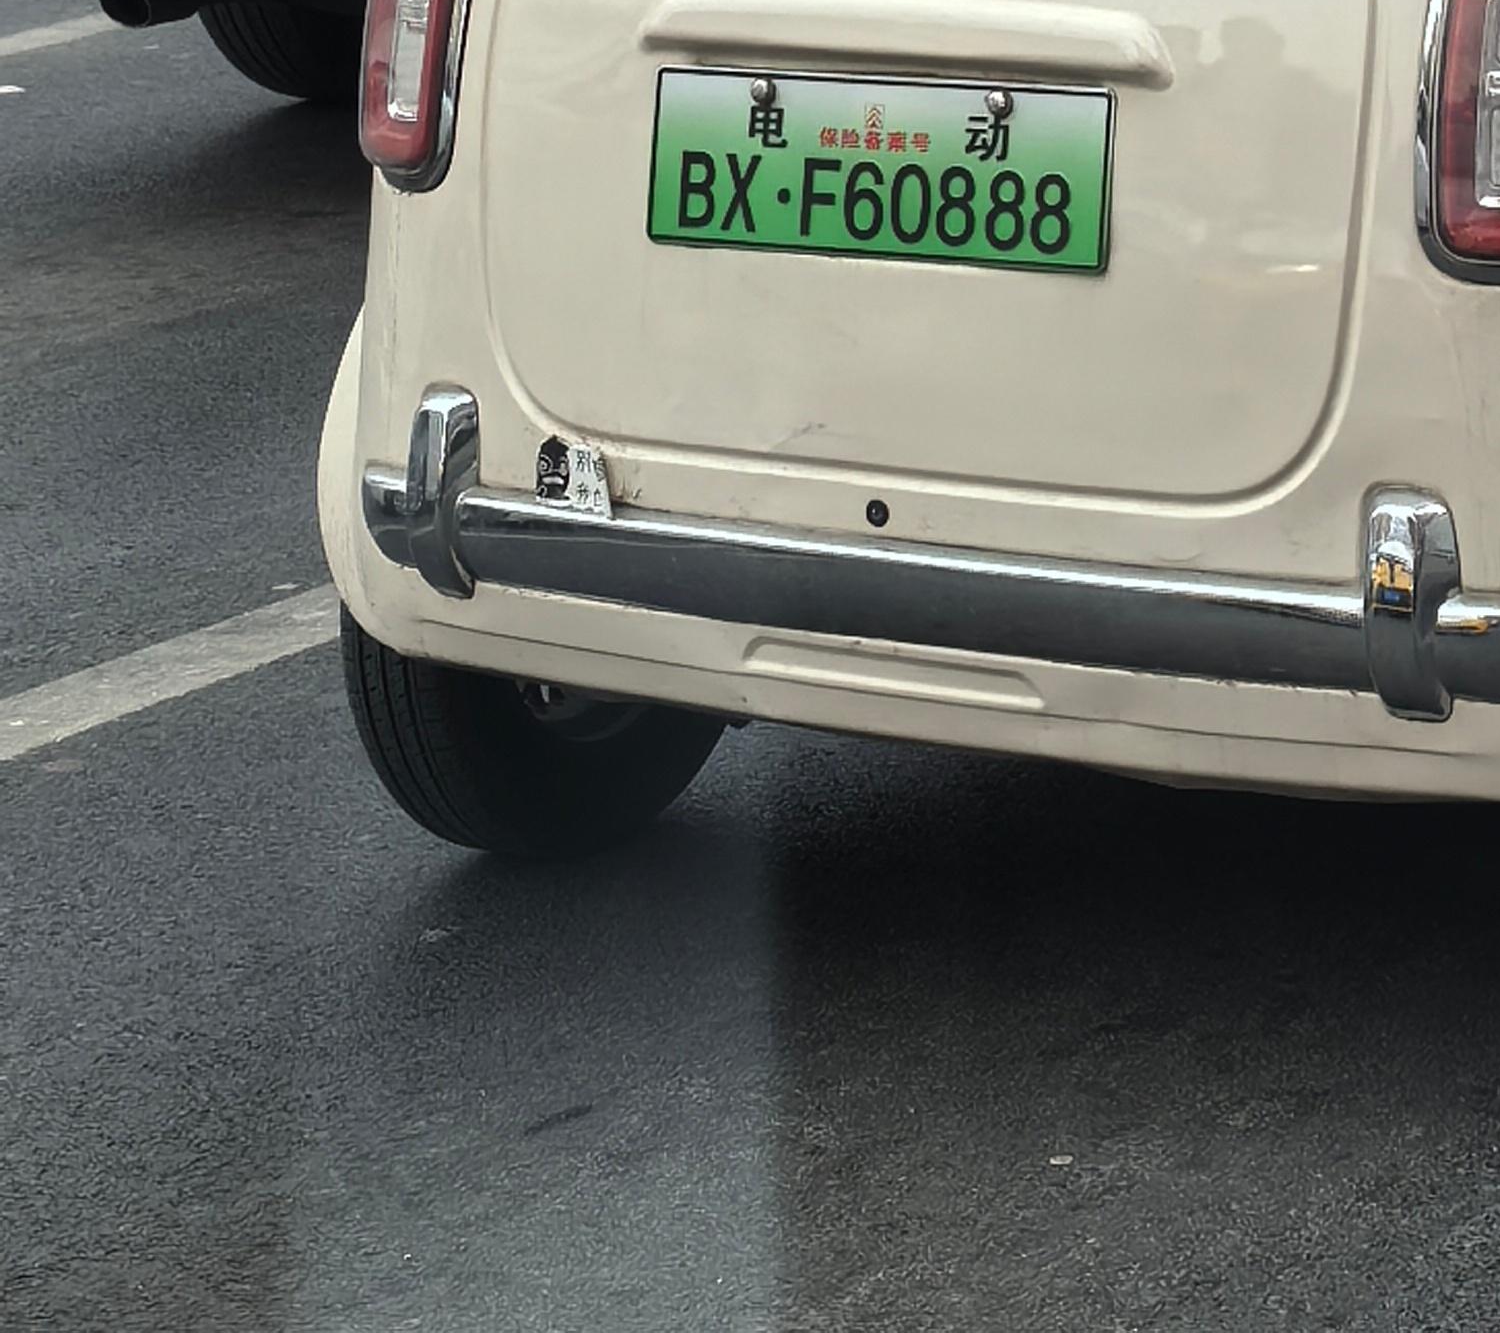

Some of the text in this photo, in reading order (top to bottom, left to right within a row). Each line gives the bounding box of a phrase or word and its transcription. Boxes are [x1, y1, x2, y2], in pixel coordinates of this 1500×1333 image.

[748, 105, 1011, 162] 电 动
[819, 126, 931, 153] 保险备案号
[677, 150, 1071, 255] BX·F60888
